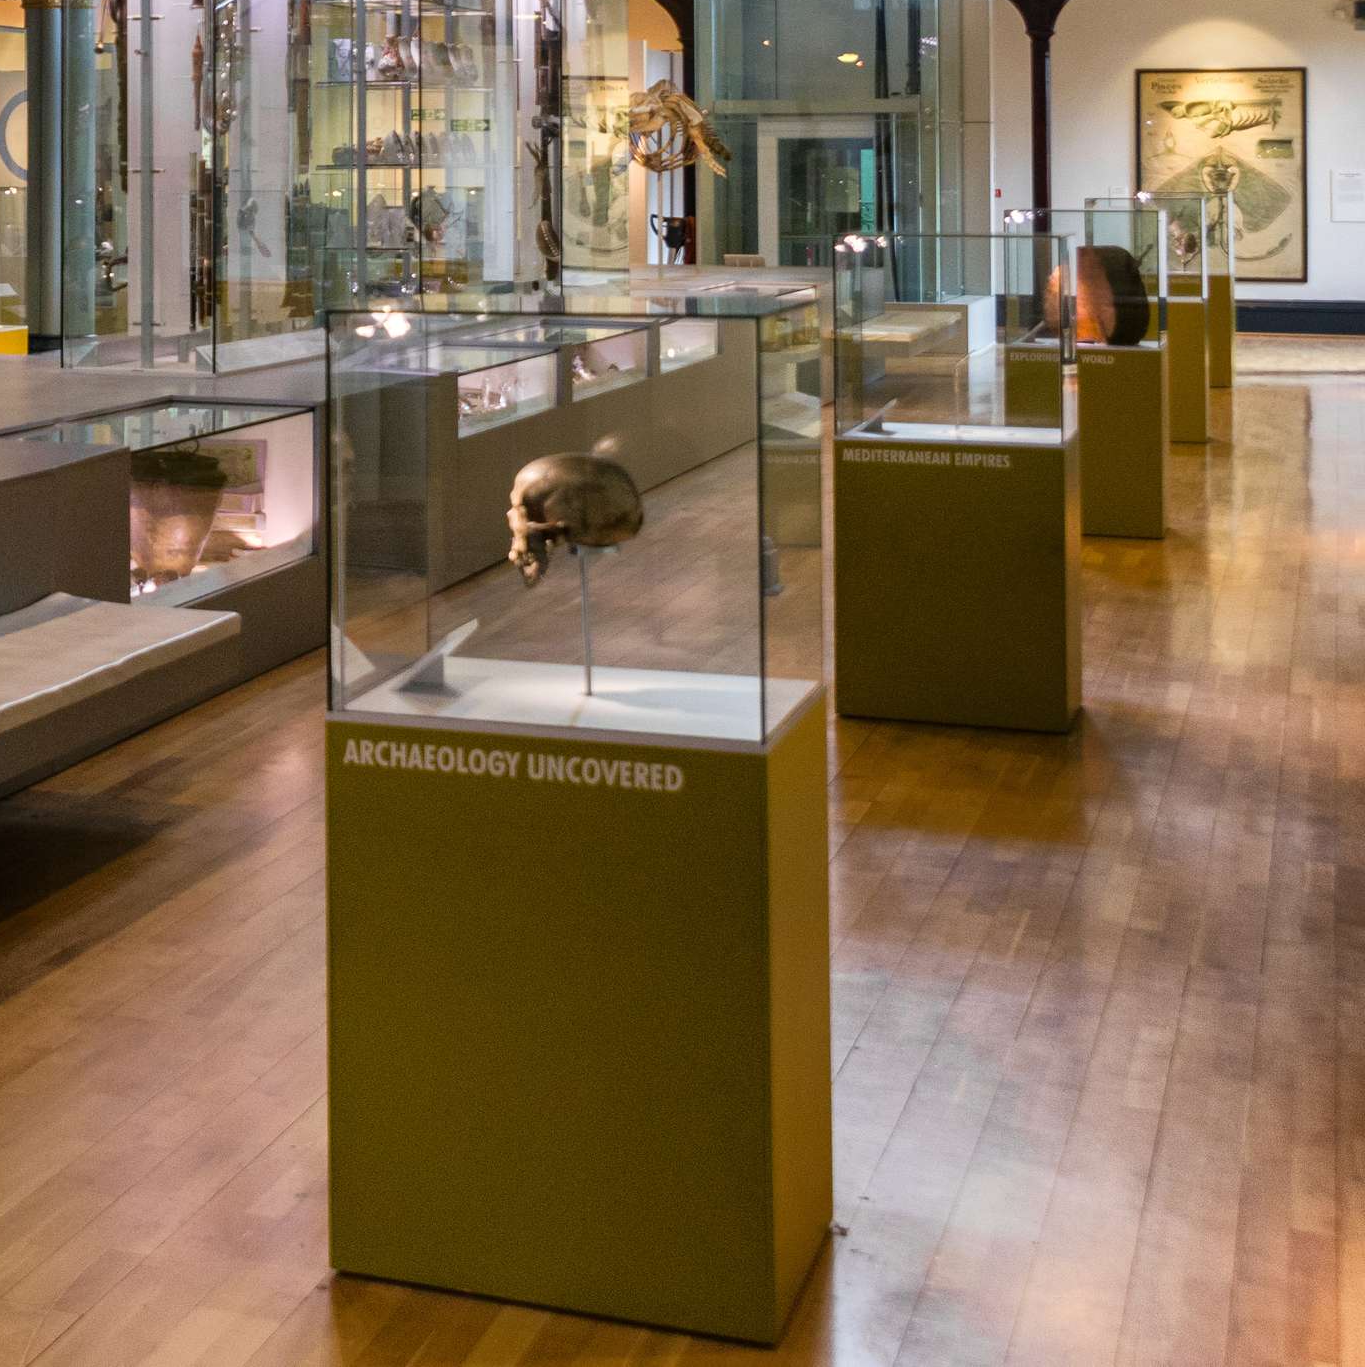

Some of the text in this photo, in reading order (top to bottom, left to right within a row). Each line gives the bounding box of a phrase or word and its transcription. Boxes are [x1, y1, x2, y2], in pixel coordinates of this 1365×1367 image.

[1080, 354, 1115, 365] WORLD
[842, 447, 1011, 467] MEDITERRANEAN EMPIRES
[342, 738, 683, 792] ARCHAEOLOGY UNCOVERED
